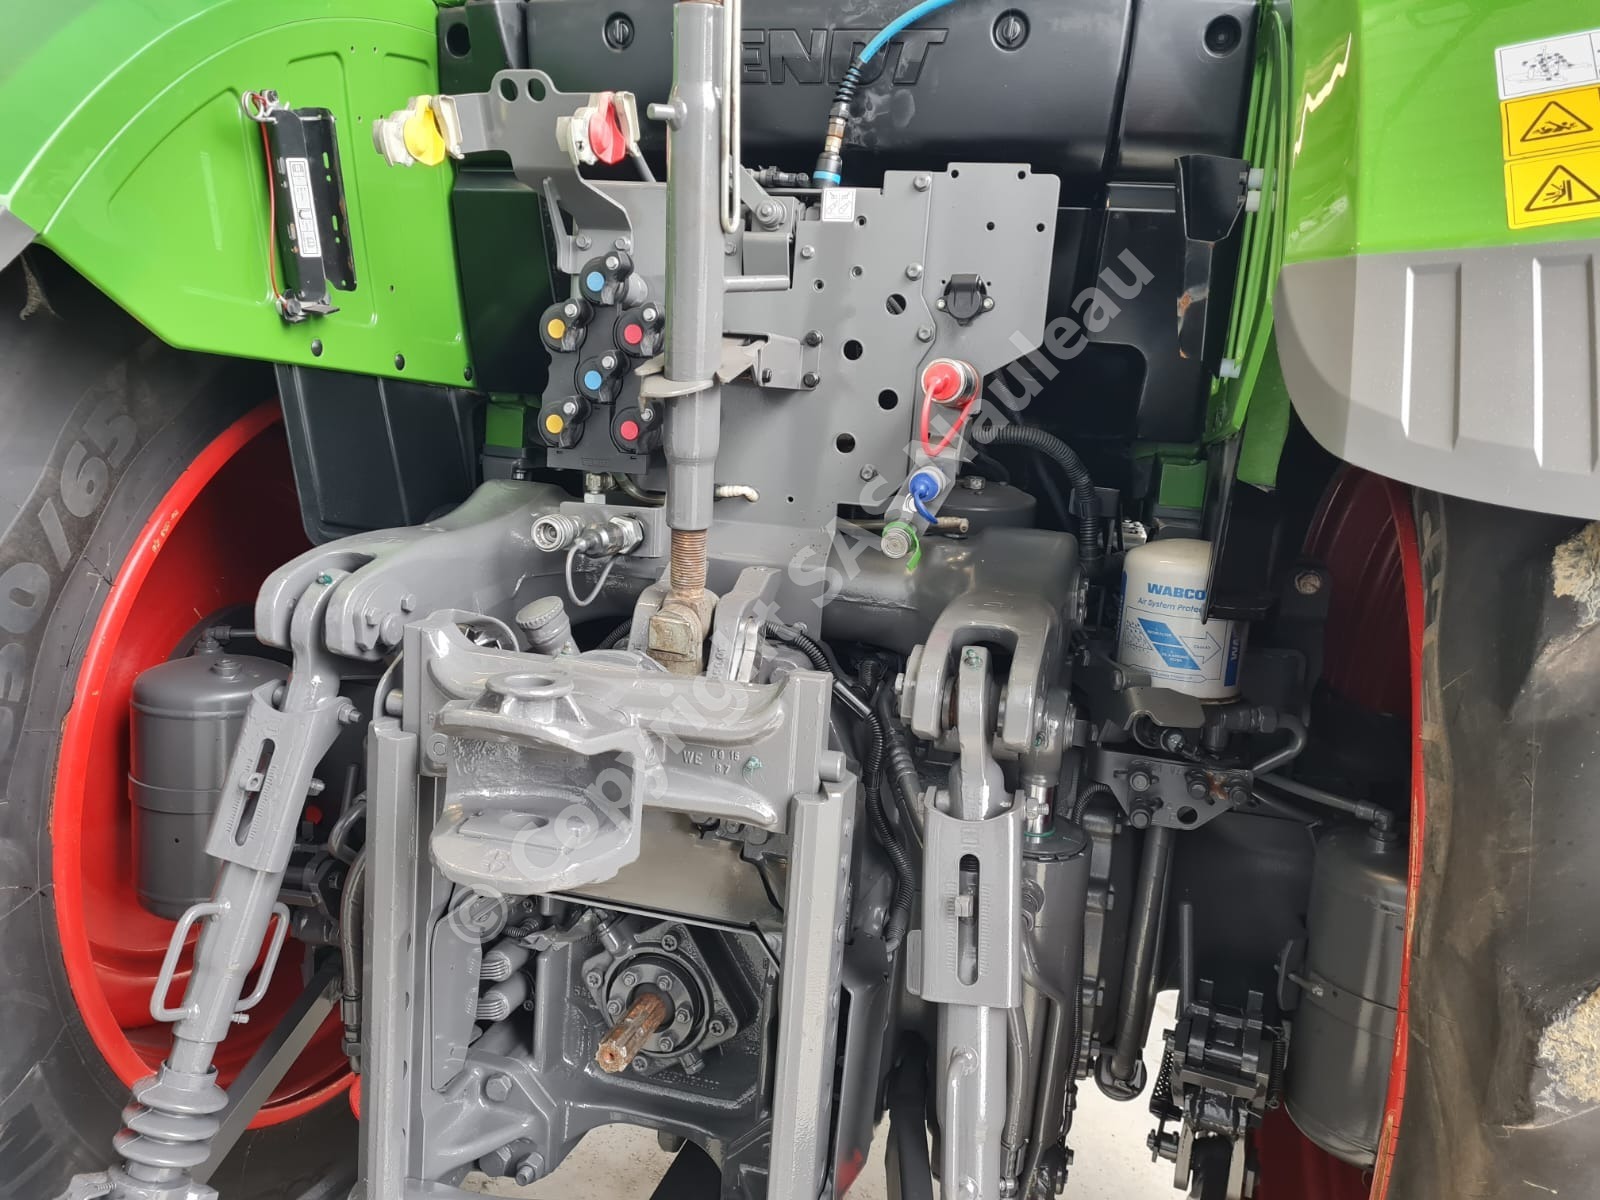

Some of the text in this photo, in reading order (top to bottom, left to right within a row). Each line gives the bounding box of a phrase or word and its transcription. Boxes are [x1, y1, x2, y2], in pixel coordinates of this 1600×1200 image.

[741, 28, 949, 84] ENDT
[1147, 582, 1207, 601] WABCO
[1147, 599, 1175, 610] System
[682, 749, 703, 765] WE
